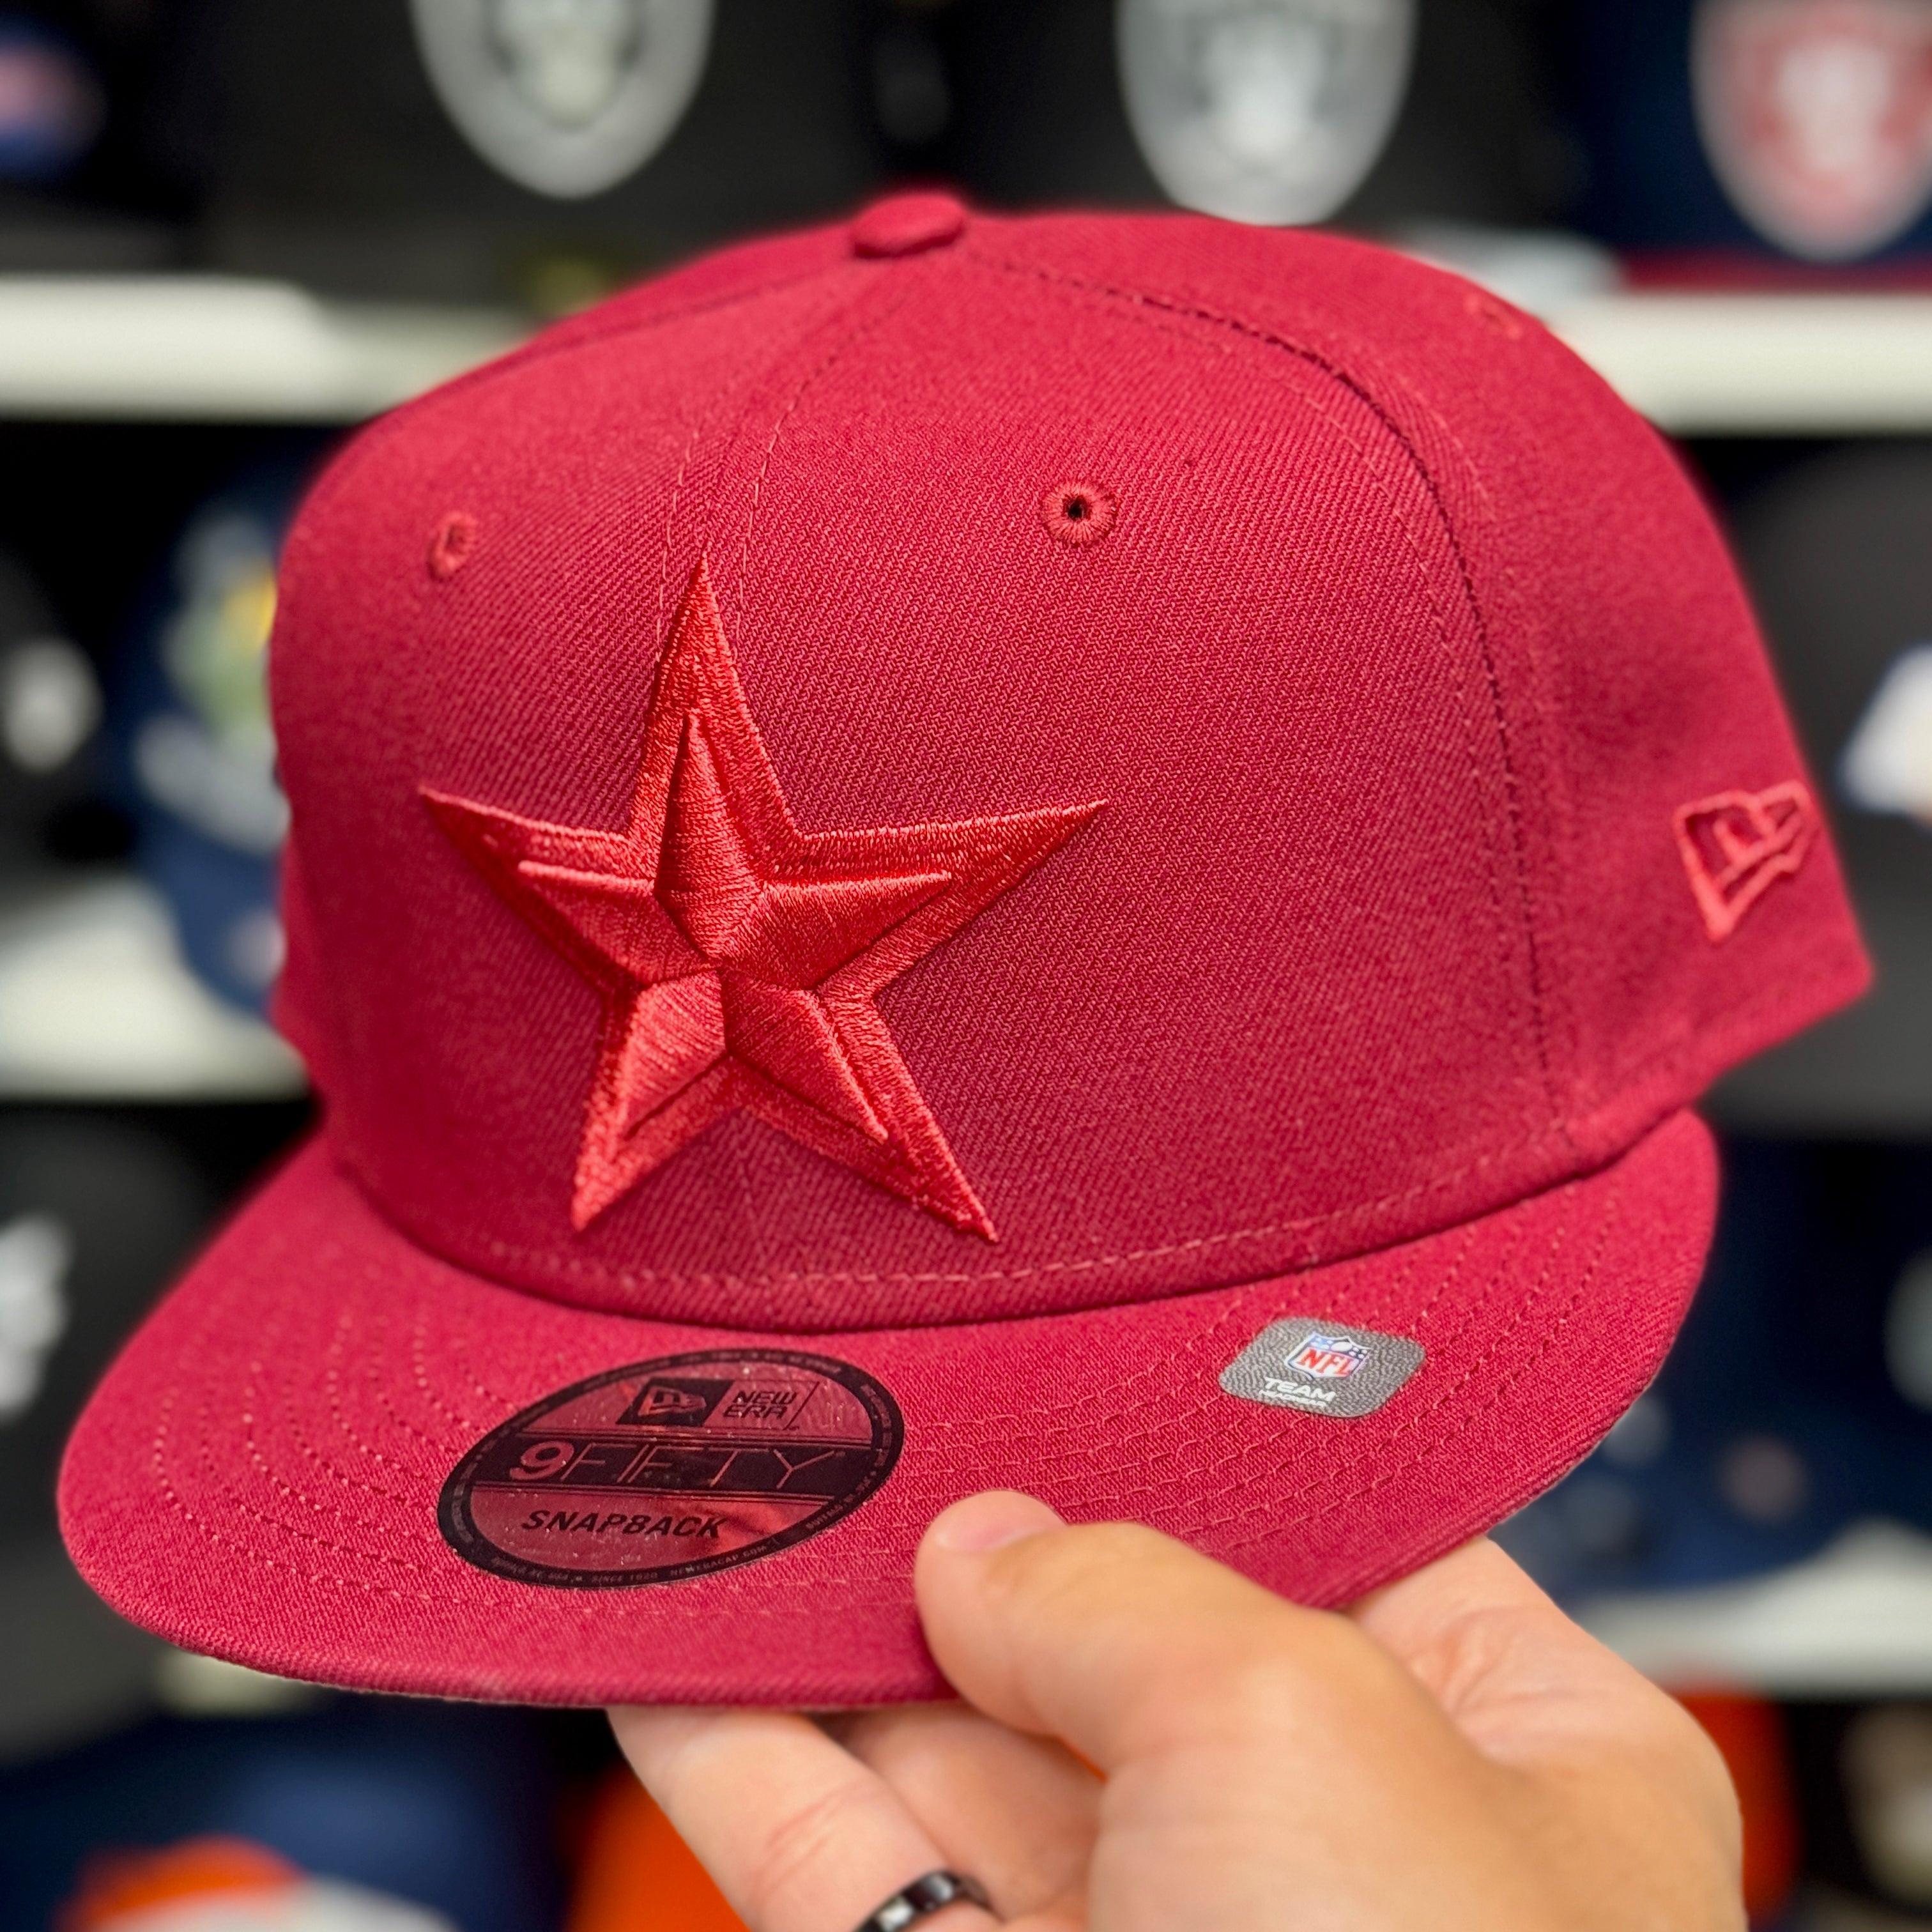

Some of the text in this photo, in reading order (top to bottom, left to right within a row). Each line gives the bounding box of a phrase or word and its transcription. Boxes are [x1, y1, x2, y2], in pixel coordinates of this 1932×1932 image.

[1297, 1349, 1354, 1376] NFL
[733, 1390, 799, 1405] NEW
[1263, 1377, 1336, 1402] TEAM
[723, 1405, 788, 1419] ERA
[510, 1440, 835, 1489] 9FIFTY
[521, 1509, 729, 1538] SNAPBACK
